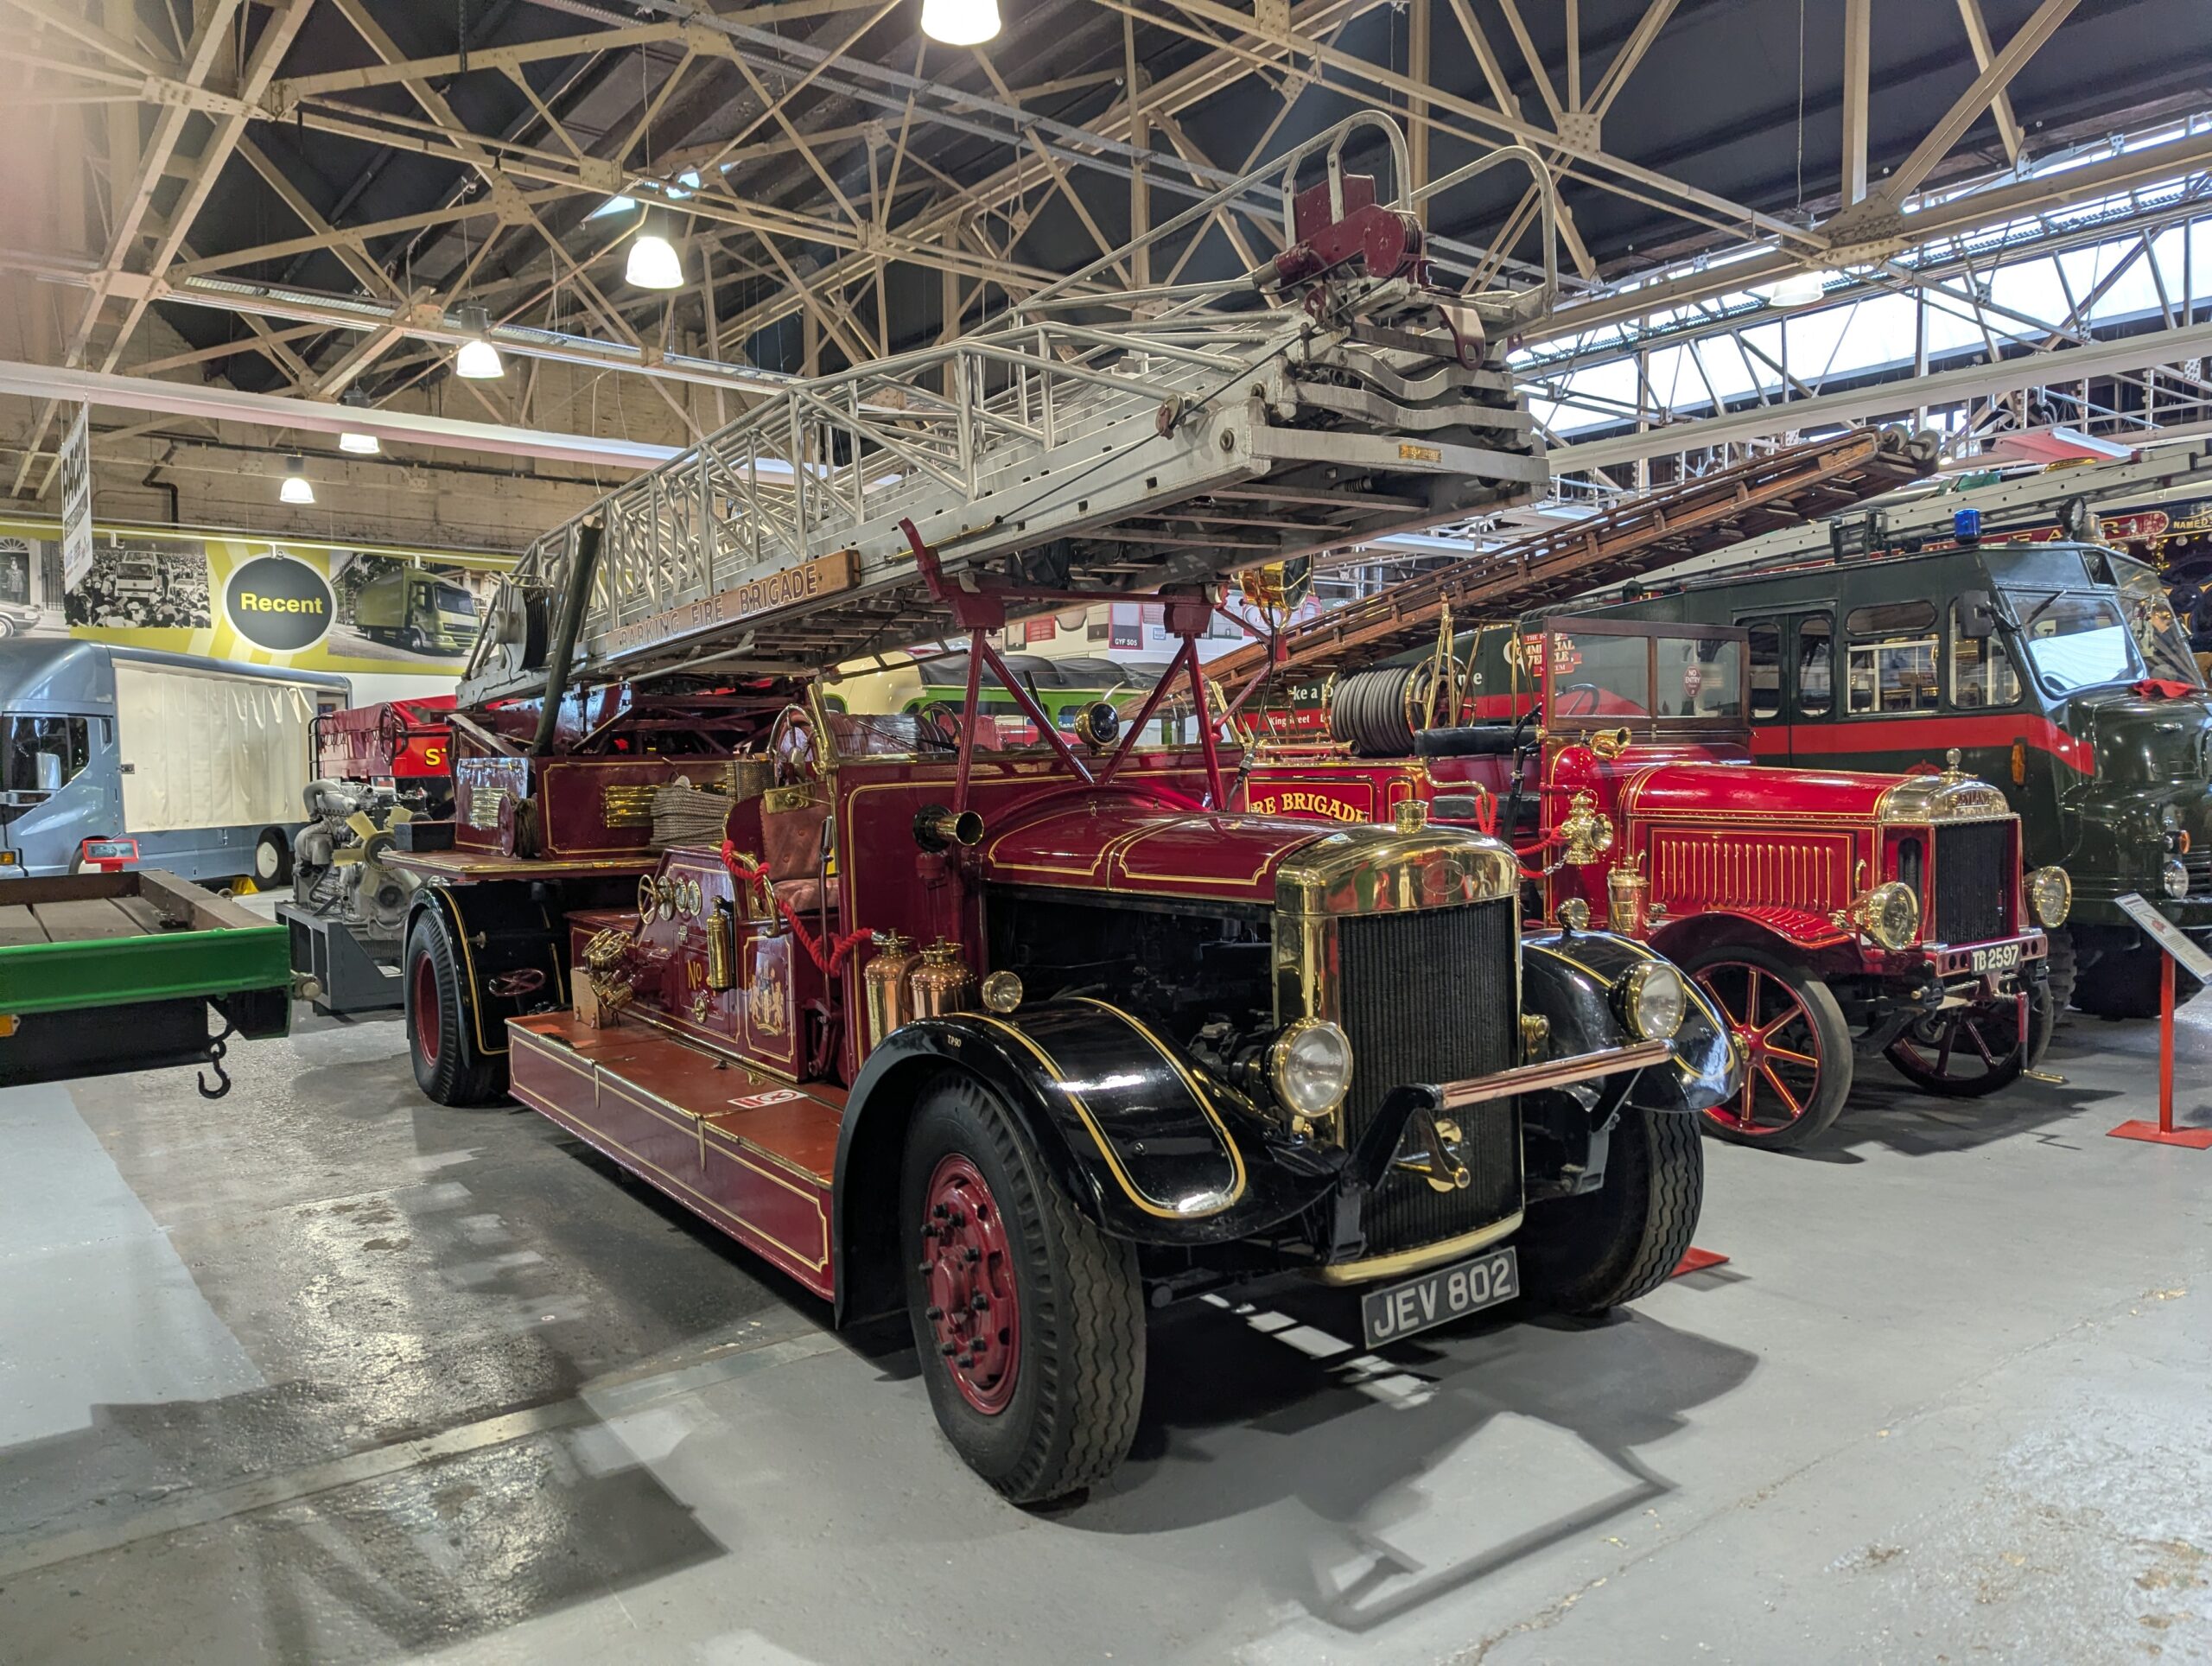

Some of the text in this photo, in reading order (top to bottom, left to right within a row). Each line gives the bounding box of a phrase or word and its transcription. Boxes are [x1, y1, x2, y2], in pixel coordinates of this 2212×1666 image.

[2173, 518, 2209, 529] NAMED
[240, 593, 323, 614] Recent
[620, 564, 818, 648] BARKING FIRE BRIGADE
[1293, 685, 1308, 701] ke
[1311, 687, 1318, 699] a
[1269, 715, 1287, 728] King
[1289, 714, 1310, 725] treet
[1250, 796, 1276, 815] RE
[1972, 944, 2019, 972] TB 2597
[1374, 1257, 1512, 1338] JEV 802
